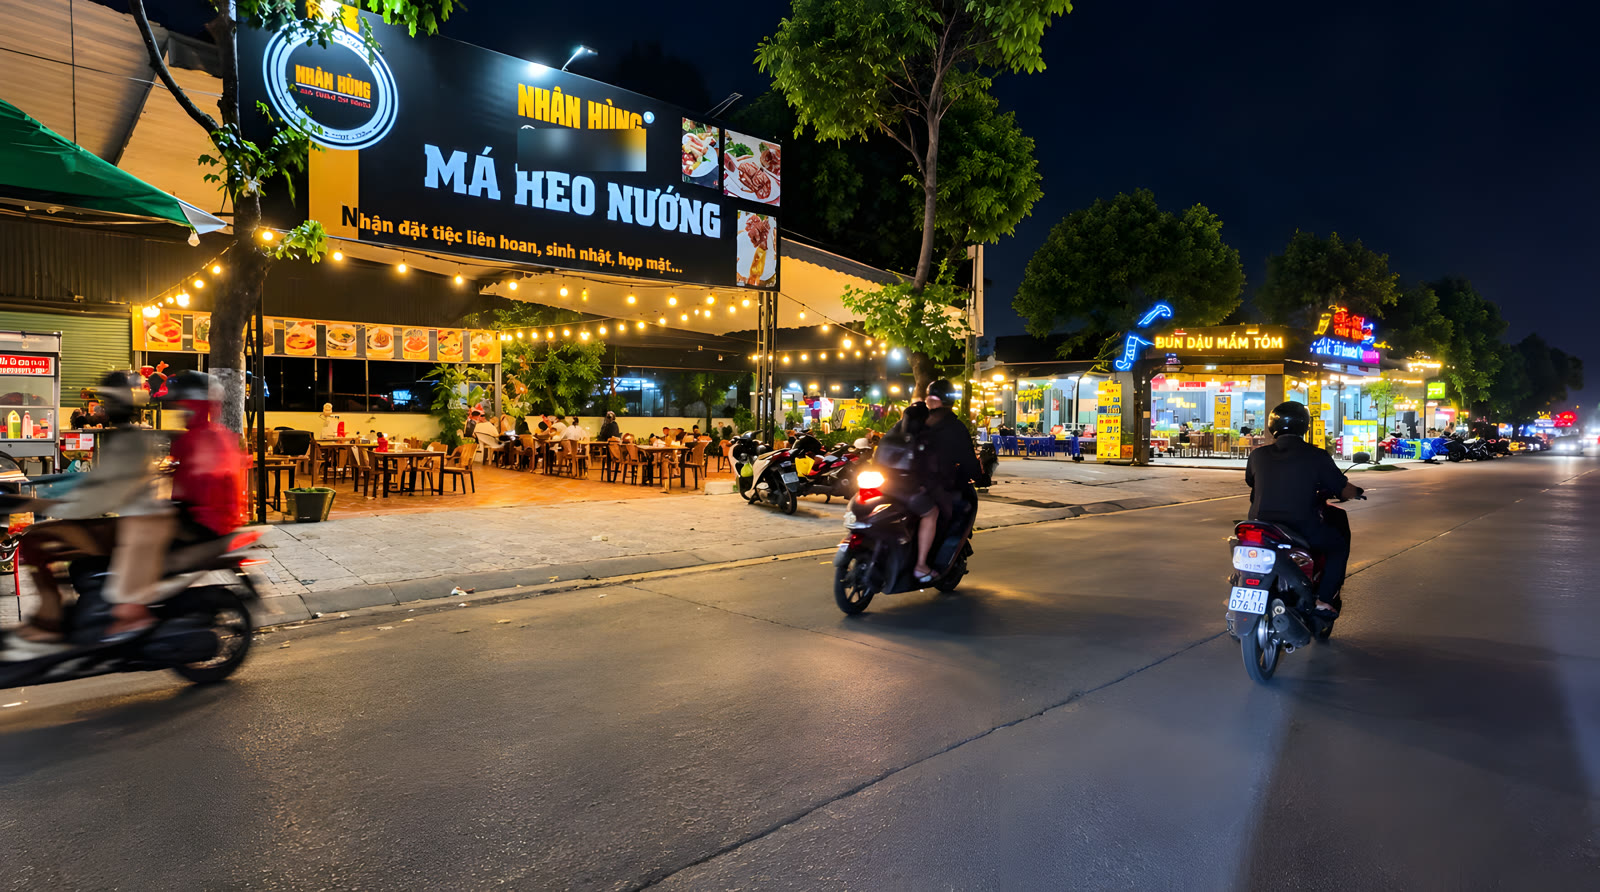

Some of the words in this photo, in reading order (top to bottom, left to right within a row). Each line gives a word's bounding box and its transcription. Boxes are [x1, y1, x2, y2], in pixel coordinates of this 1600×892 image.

[295, 64, 333, 90] NHÂN
[337, 73, 371, 99] HÙNG
[518, 83, 581, 129] NHÂN
[424, 143, 500, 200] MÁ
[515, 163, 595, 216] HEO
[607, 182, 721, 238] NƯỚNG
[342, 205, 393, 235] Nhận
[398, 220, 428, 240] đặt
[432, 225, 463, 245] tiệc
[467, 230, 496, 248] liên
[500, 234, 542, 257] hoan,
[545, 242, 576, 259] sinh
[580, 248, 615, 267] nhật,
[618, 251, 643, 271] họp
[646, 257, 683, 274] mặt...
